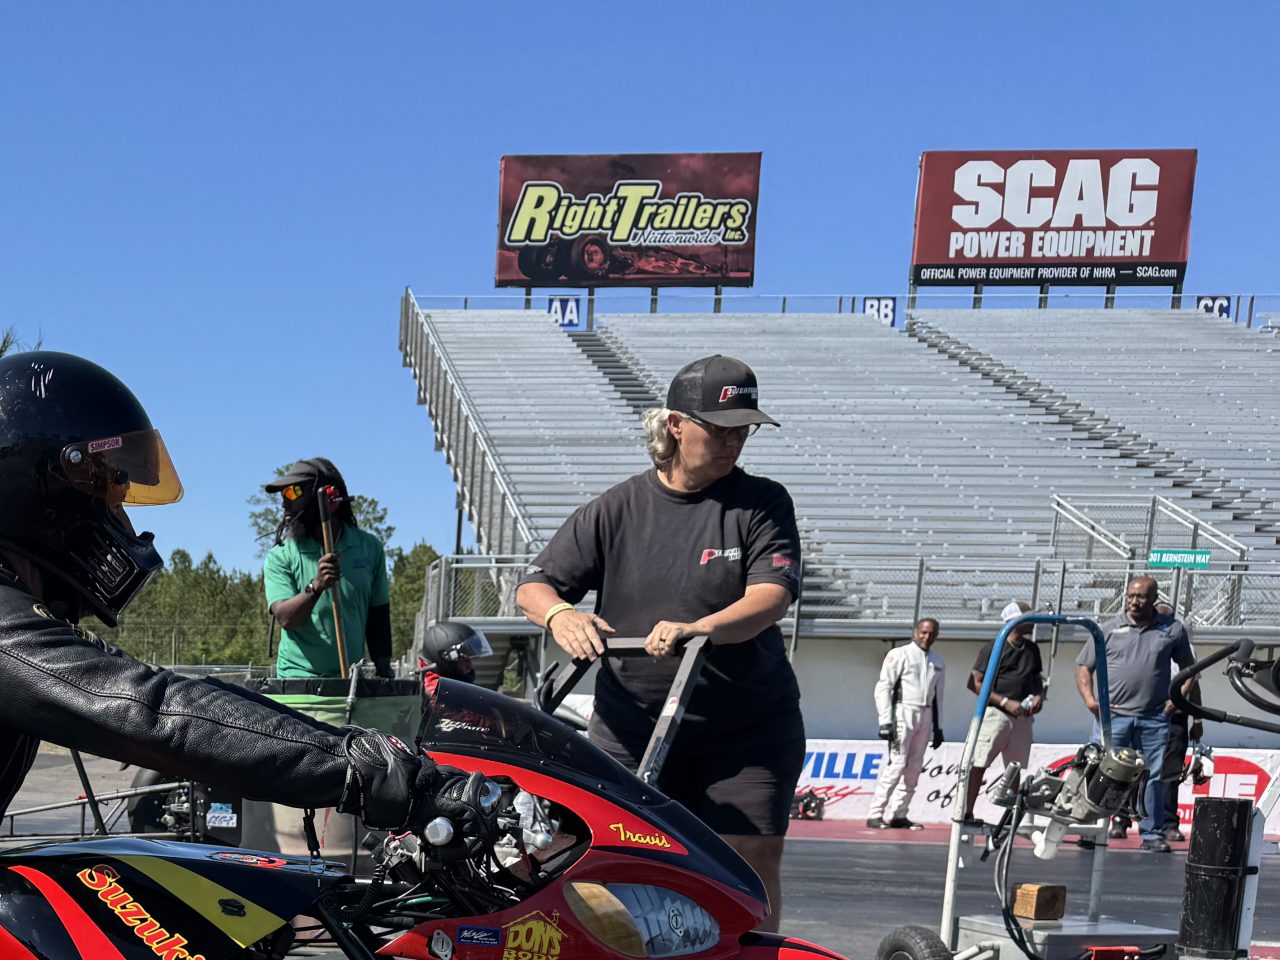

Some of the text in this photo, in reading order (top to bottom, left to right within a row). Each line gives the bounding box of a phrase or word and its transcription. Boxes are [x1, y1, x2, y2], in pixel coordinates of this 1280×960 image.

[952, 159, 1160, 229] SCAG
[631, 229, 719, 245] Nationwide
[949, 229, 1154, 258] POWER EQUIPMENT
[921, 265, 1177, 280] OFFICIAL POWER EQUIPMENT PROVIDER OF NHRA SCAG.com
[550, 298, 580, 326] AA
[865, 298, 894, 326] BB
[1197, 297, 1230, 318] CC
[90, 439, 121, 451] SIMPSON
[1149, 552, 1210, 564] 301 BERNSTEIN WAY
[609, 823, 671, 848] Travis
[507, 919, 562, 955] DON'S
